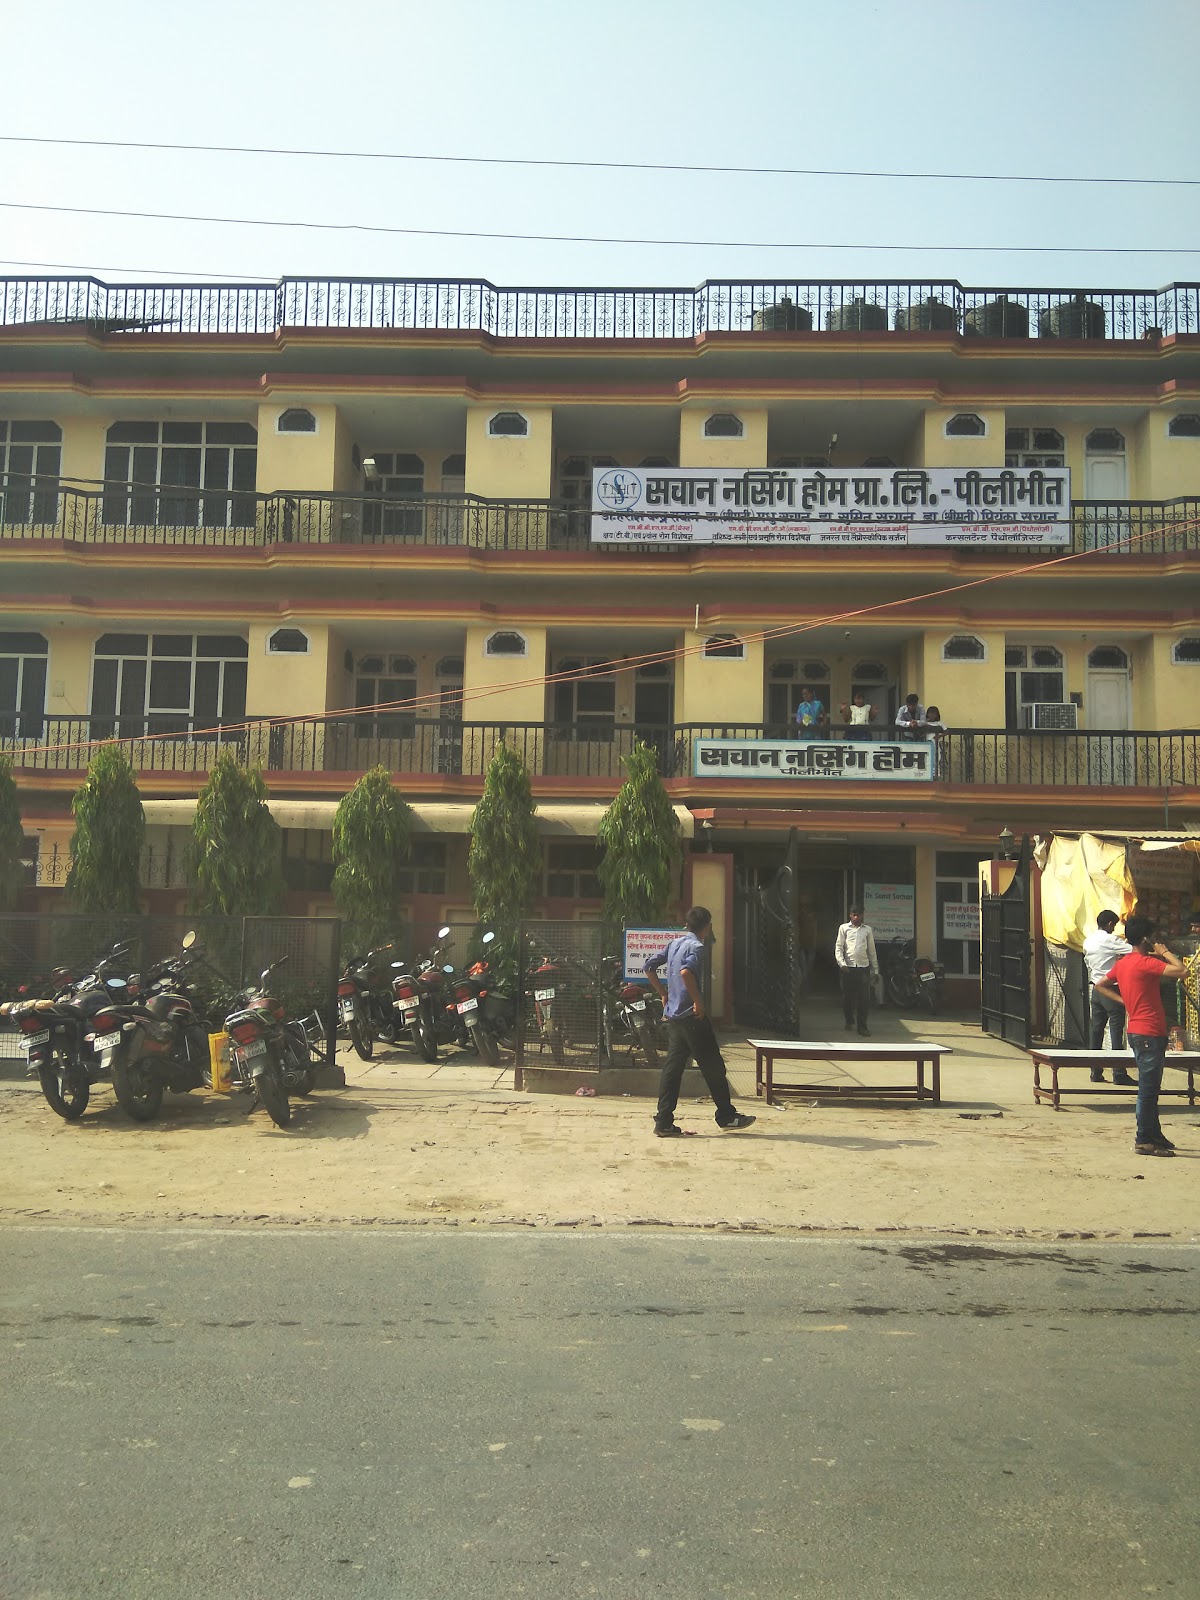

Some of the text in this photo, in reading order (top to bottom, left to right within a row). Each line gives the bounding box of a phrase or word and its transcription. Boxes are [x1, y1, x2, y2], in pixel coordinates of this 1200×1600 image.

[646, 478, 718, 505] सचान
[723, 471, 797, 506] नर्सिंग
[802, 471, 849, 510] होम
[701, 745, 928, 772] सचान नर्सिंग होम
[780, 767, 843, 777] पीलीभीत
